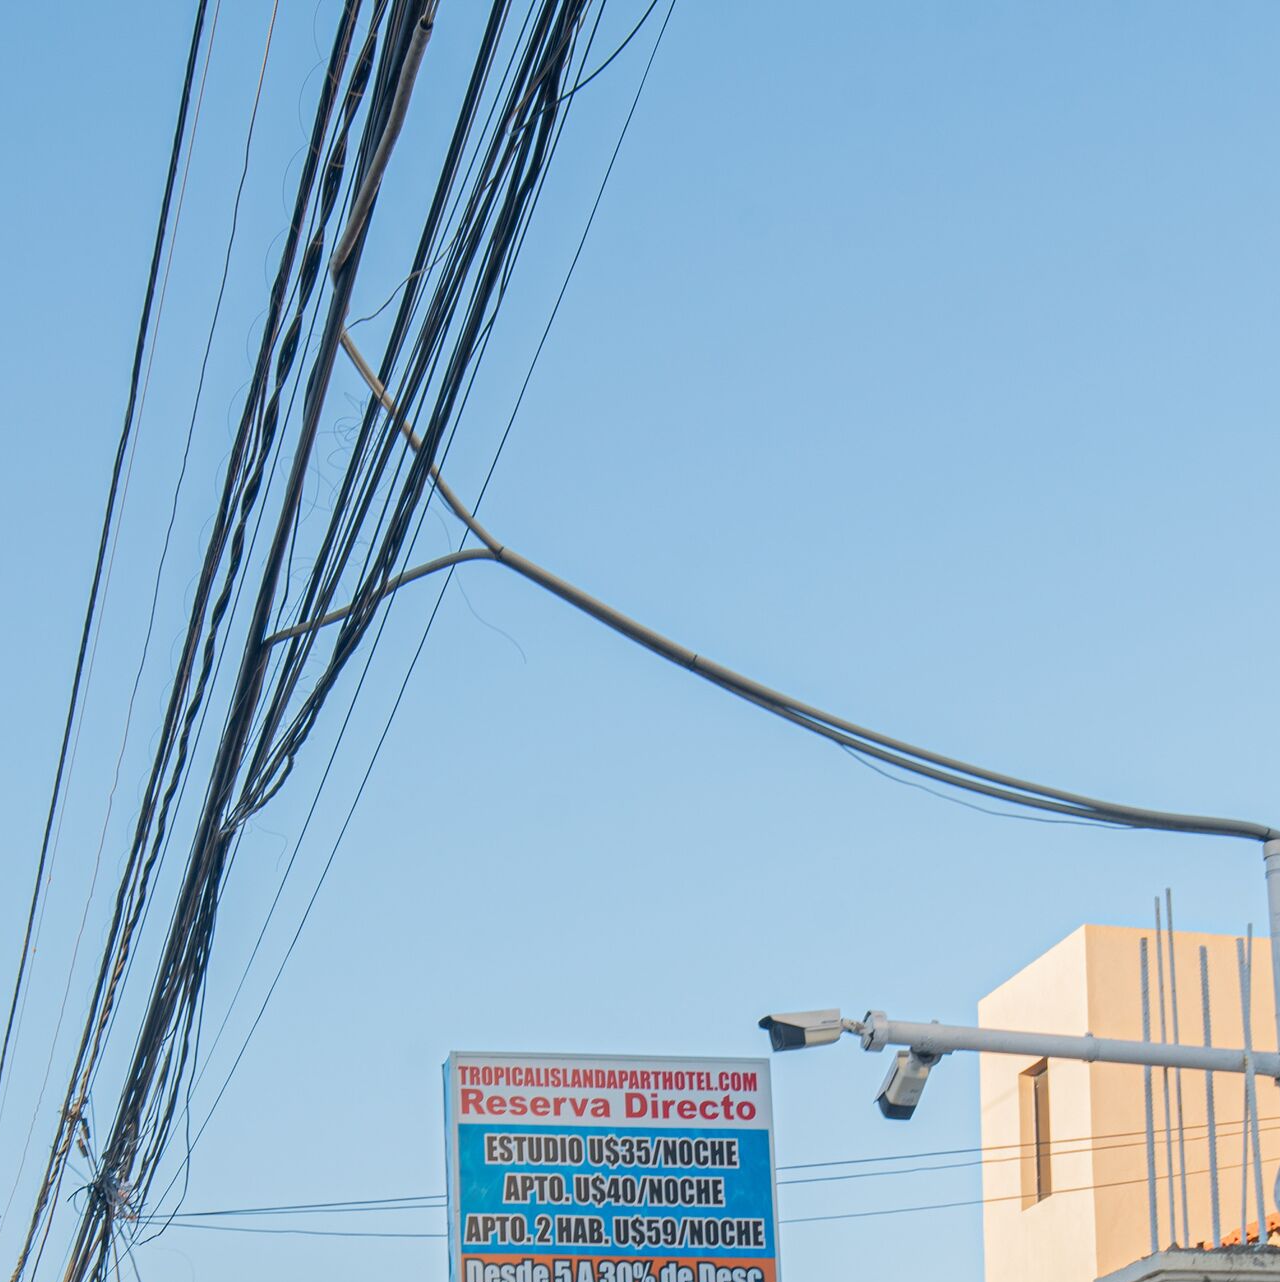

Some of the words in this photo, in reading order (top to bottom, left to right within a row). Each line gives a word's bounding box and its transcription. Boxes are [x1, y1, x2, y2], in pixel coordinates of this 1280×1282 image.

[458, 1066, 757, 1091] TROPICALISLANDAPARTHOTEL.COM
[461, 1089, 610, 1117] Reserva
[625, 1093, 756, 1121] Directo
[485, 1134, 583, 1165] ESTUDIO
[588, 1137, 738, 1167] U$35/NOCHE
[504, 1174, 571, 1203] APTO.
[575, 1177, 724, 1206] U$40/NOCHE
[465, 1215, 531, 1244] APTO.
[536, 1217, 551, 1244] 2
[557, 1217, 609, 1245] HAB.
[615, 1218, 765, 1248] U$59/NOCHE
